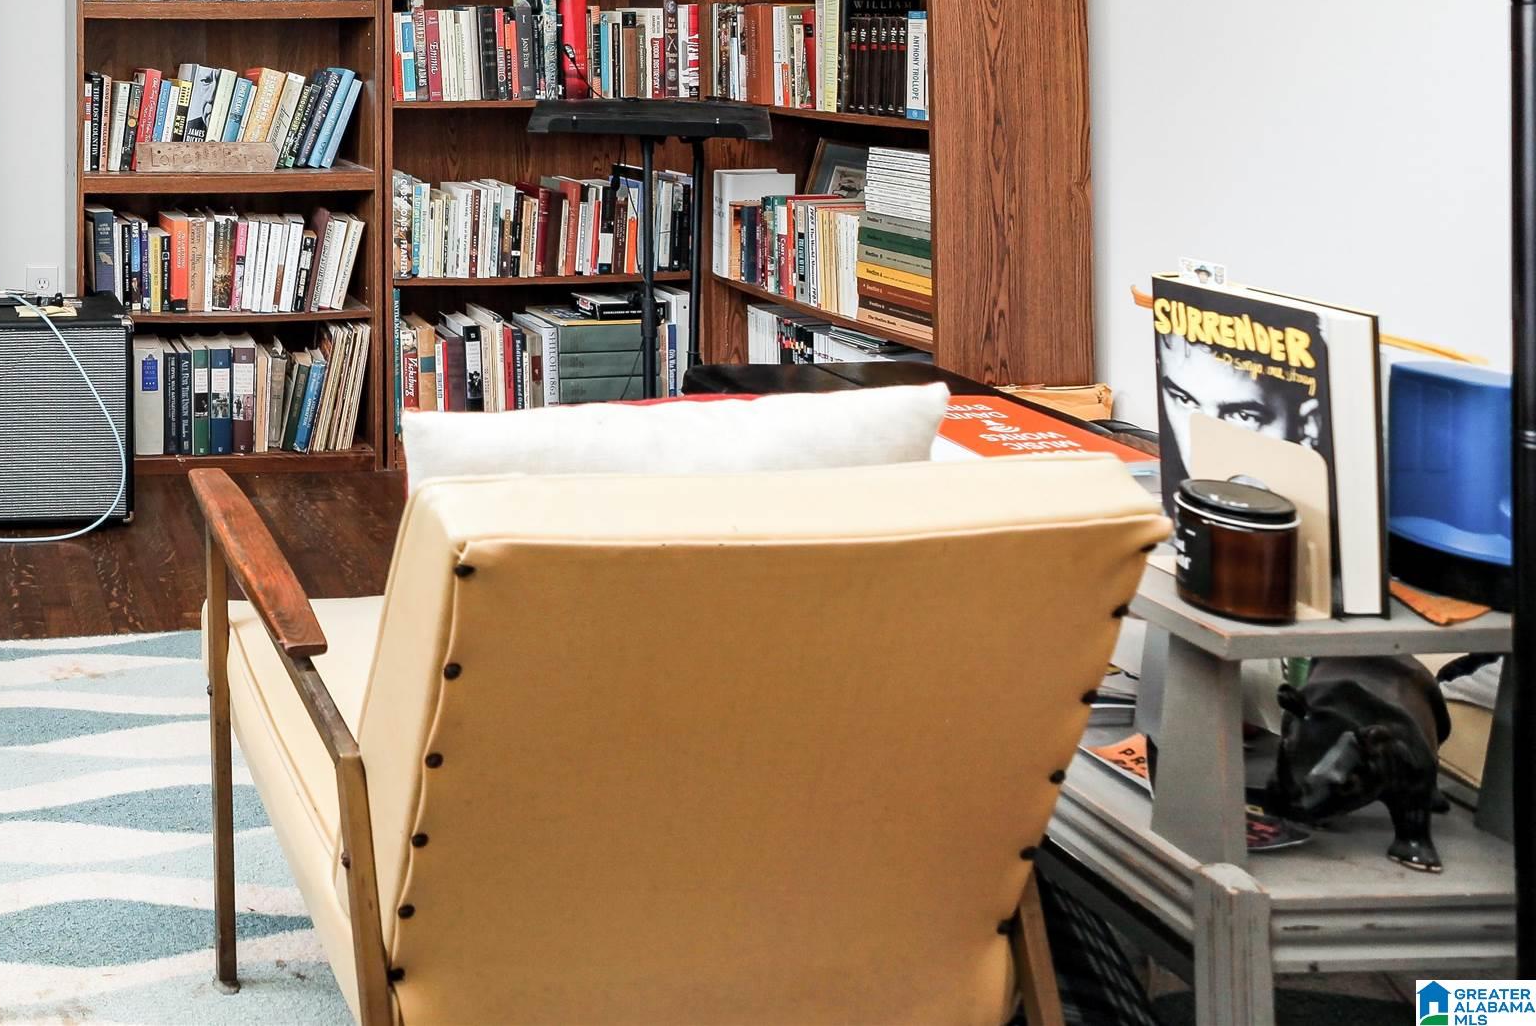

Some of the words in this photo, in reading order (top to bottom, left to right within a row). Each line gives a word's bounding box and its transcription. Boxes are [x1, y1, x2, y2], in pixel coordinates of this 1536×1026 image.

[852, 0, 913, 10] WILLIAM
[521, 38, 529, 51] JANE
[911, 35, 921, 66] ANTHONY
[429, 40, 440, 75] Emma
[521, 53, 529, 69] EYRE
[652, 57, 661, 90] DOSTOEVSKY
[326, 74, 340, 96] HARPER
[911, 68, 921, 101] TROLLOPE
[91, 88, 99, 101] THE
[91, 103, 99, 122] LOST
[322, 99, 331, 111] LEE
[91, 123, 99, 156] COUNTRY
[187, 128, 205, 137] JAMES
[400, 179, 409, 232] CROSSROADS
[132, 223, 140, 238] TAPS
[400, 240, 409, 278] FRANZEN
[1154, 298, 1316, 369] SURRENDER
[405, 357, 419, 397] Vicksburg
[549, 376, 558, 395] 1862
[979, 432, 1067, 442] WORKS
[1002, 440, 1081, 450] MUSIC
